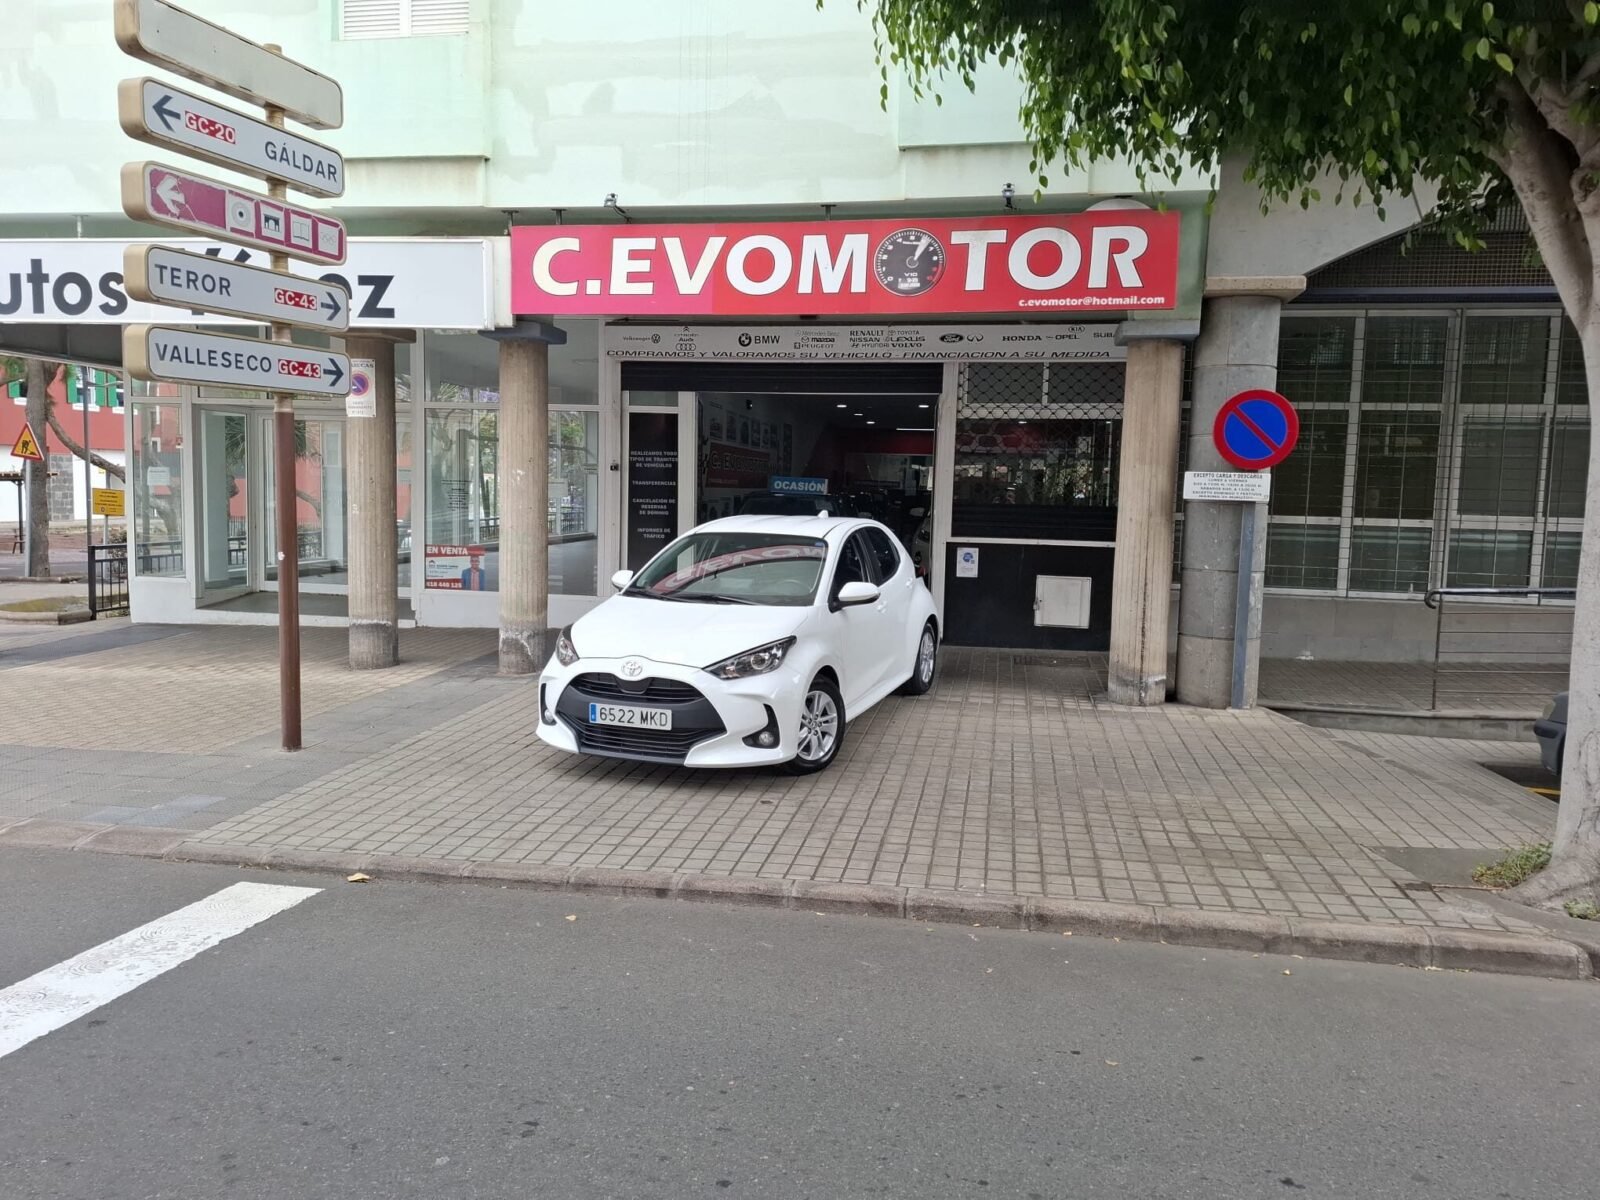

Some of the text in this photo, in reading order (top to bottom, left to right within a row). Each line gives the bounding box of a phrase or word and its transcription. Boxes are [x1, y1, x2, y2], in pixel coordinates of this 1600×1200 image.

[185, 112, 236, 144] GC-20
[264, 142, 338, 183] GÁLDAR
[154, 263, 231, 297] TEROR
[275, 289, 317, 310] GC-43
[1018, 295, 1165, 307] c.evomotor@hotmail.com
[754, 335, 781, 345] BMW
[155, 343, 272, 373] VALLESECO
[606, 349, 695, 358] COMPRAMOS
[712, 351, 798, 359] VALORAMOS
[799, 351, 820, 359] SU
[823, 351, 892, 359] VEHICULO
[902, 350, 1008, 359] FINANCIACION
[1009, 350, 1020, 358] A
[1023, 350, 1046, 358] SU
[1050, 350, 1111, 358] MEDIDA
[278, 359, 321, 378] GC-43
[774, 478, 825, 492] OCASIÓN
[426, 546, 468, 556] EN VENTA
[599, 706, 668, 727] 6522 MKD
